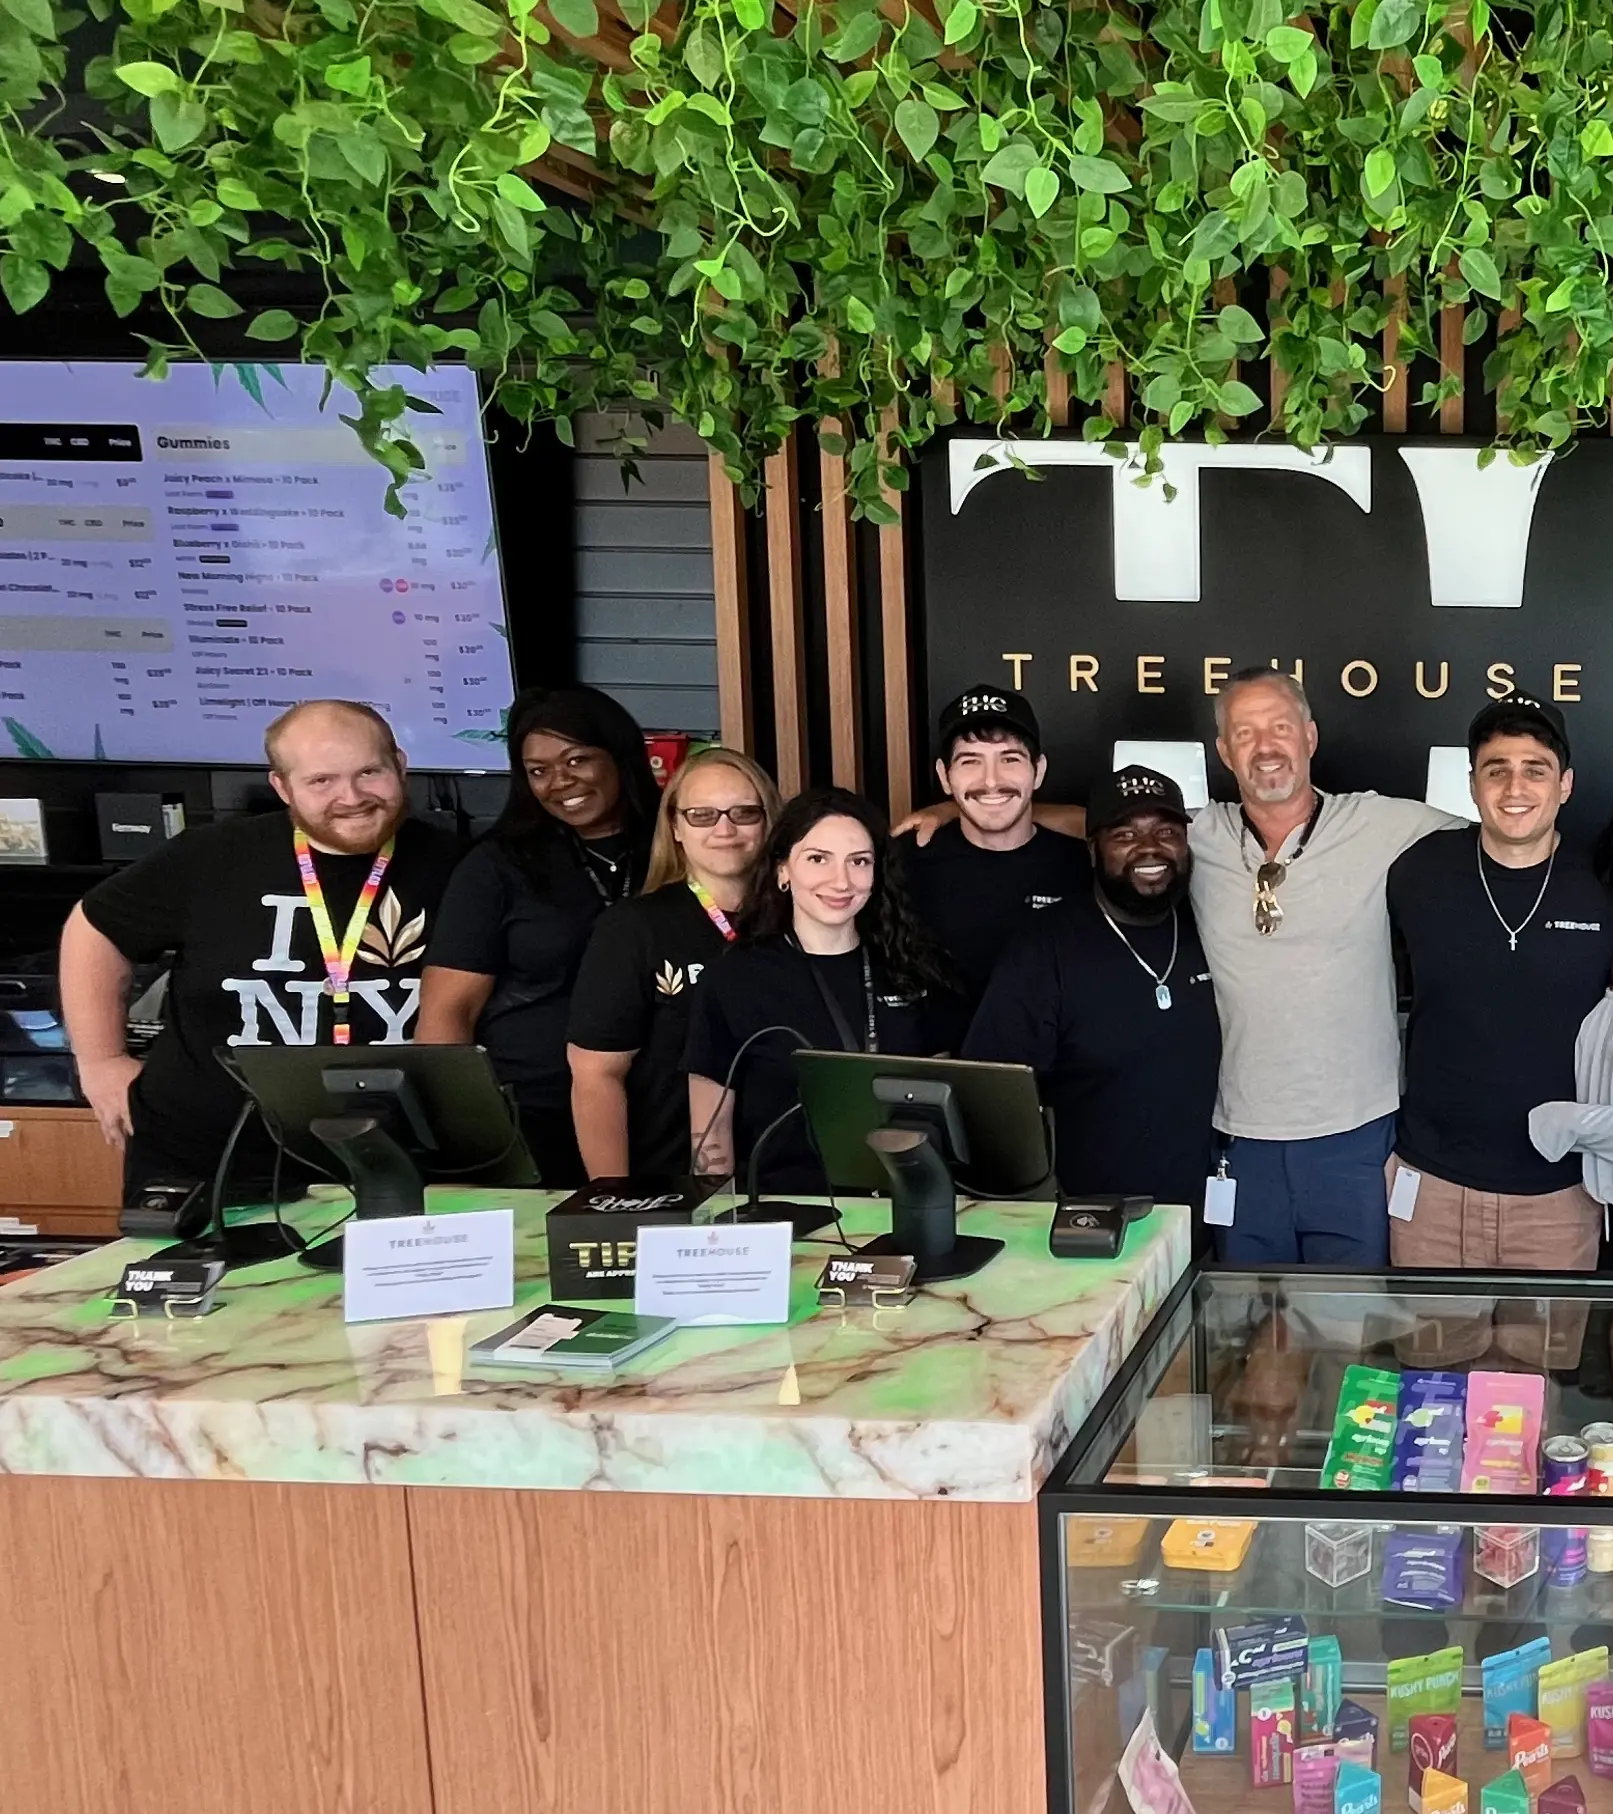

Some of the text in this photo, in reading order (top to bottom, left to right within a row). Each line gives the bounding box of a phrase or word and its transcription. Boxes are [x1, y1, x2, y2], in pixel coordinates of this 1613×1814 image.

[157, 435, 231, 450] Gummies
[191, 475, 223, 484] Peach
[294, 475, 319, 485] Pack
[167, 506, 220, 518] Raspberry
[320, 508, 345, 518] Pack
[173, 539, 222, 550] Blueberry
[280, 541, 305, 550] Pack
[202, 572, 244, 584] Morning
[294, 574, 319, 582] Pack
[216, 604, 238, 613] Free
[287, 605, 312, 614] Pack
[260, 636, 285, 645] Pack
[288, 668, 313, 677] Pack
[252, 894, 310, 972] I
[222, 978, 421, 1046] NY
[388, 1234, 469, 1250] TREEHOUSE
[568, 1242, 636, 1268] TIP
[676, 1246, 751, 1258] TREEHOUSE
[831, 1260, 875, 1274] THANK
[128, 1270, 174, 1282] THANK
[829, 1270, 856, 1282] YOU
[125, 1281, 154, 1292] YOU
[1390, 1671, 1461, 1699] KUSHY PUNCH
